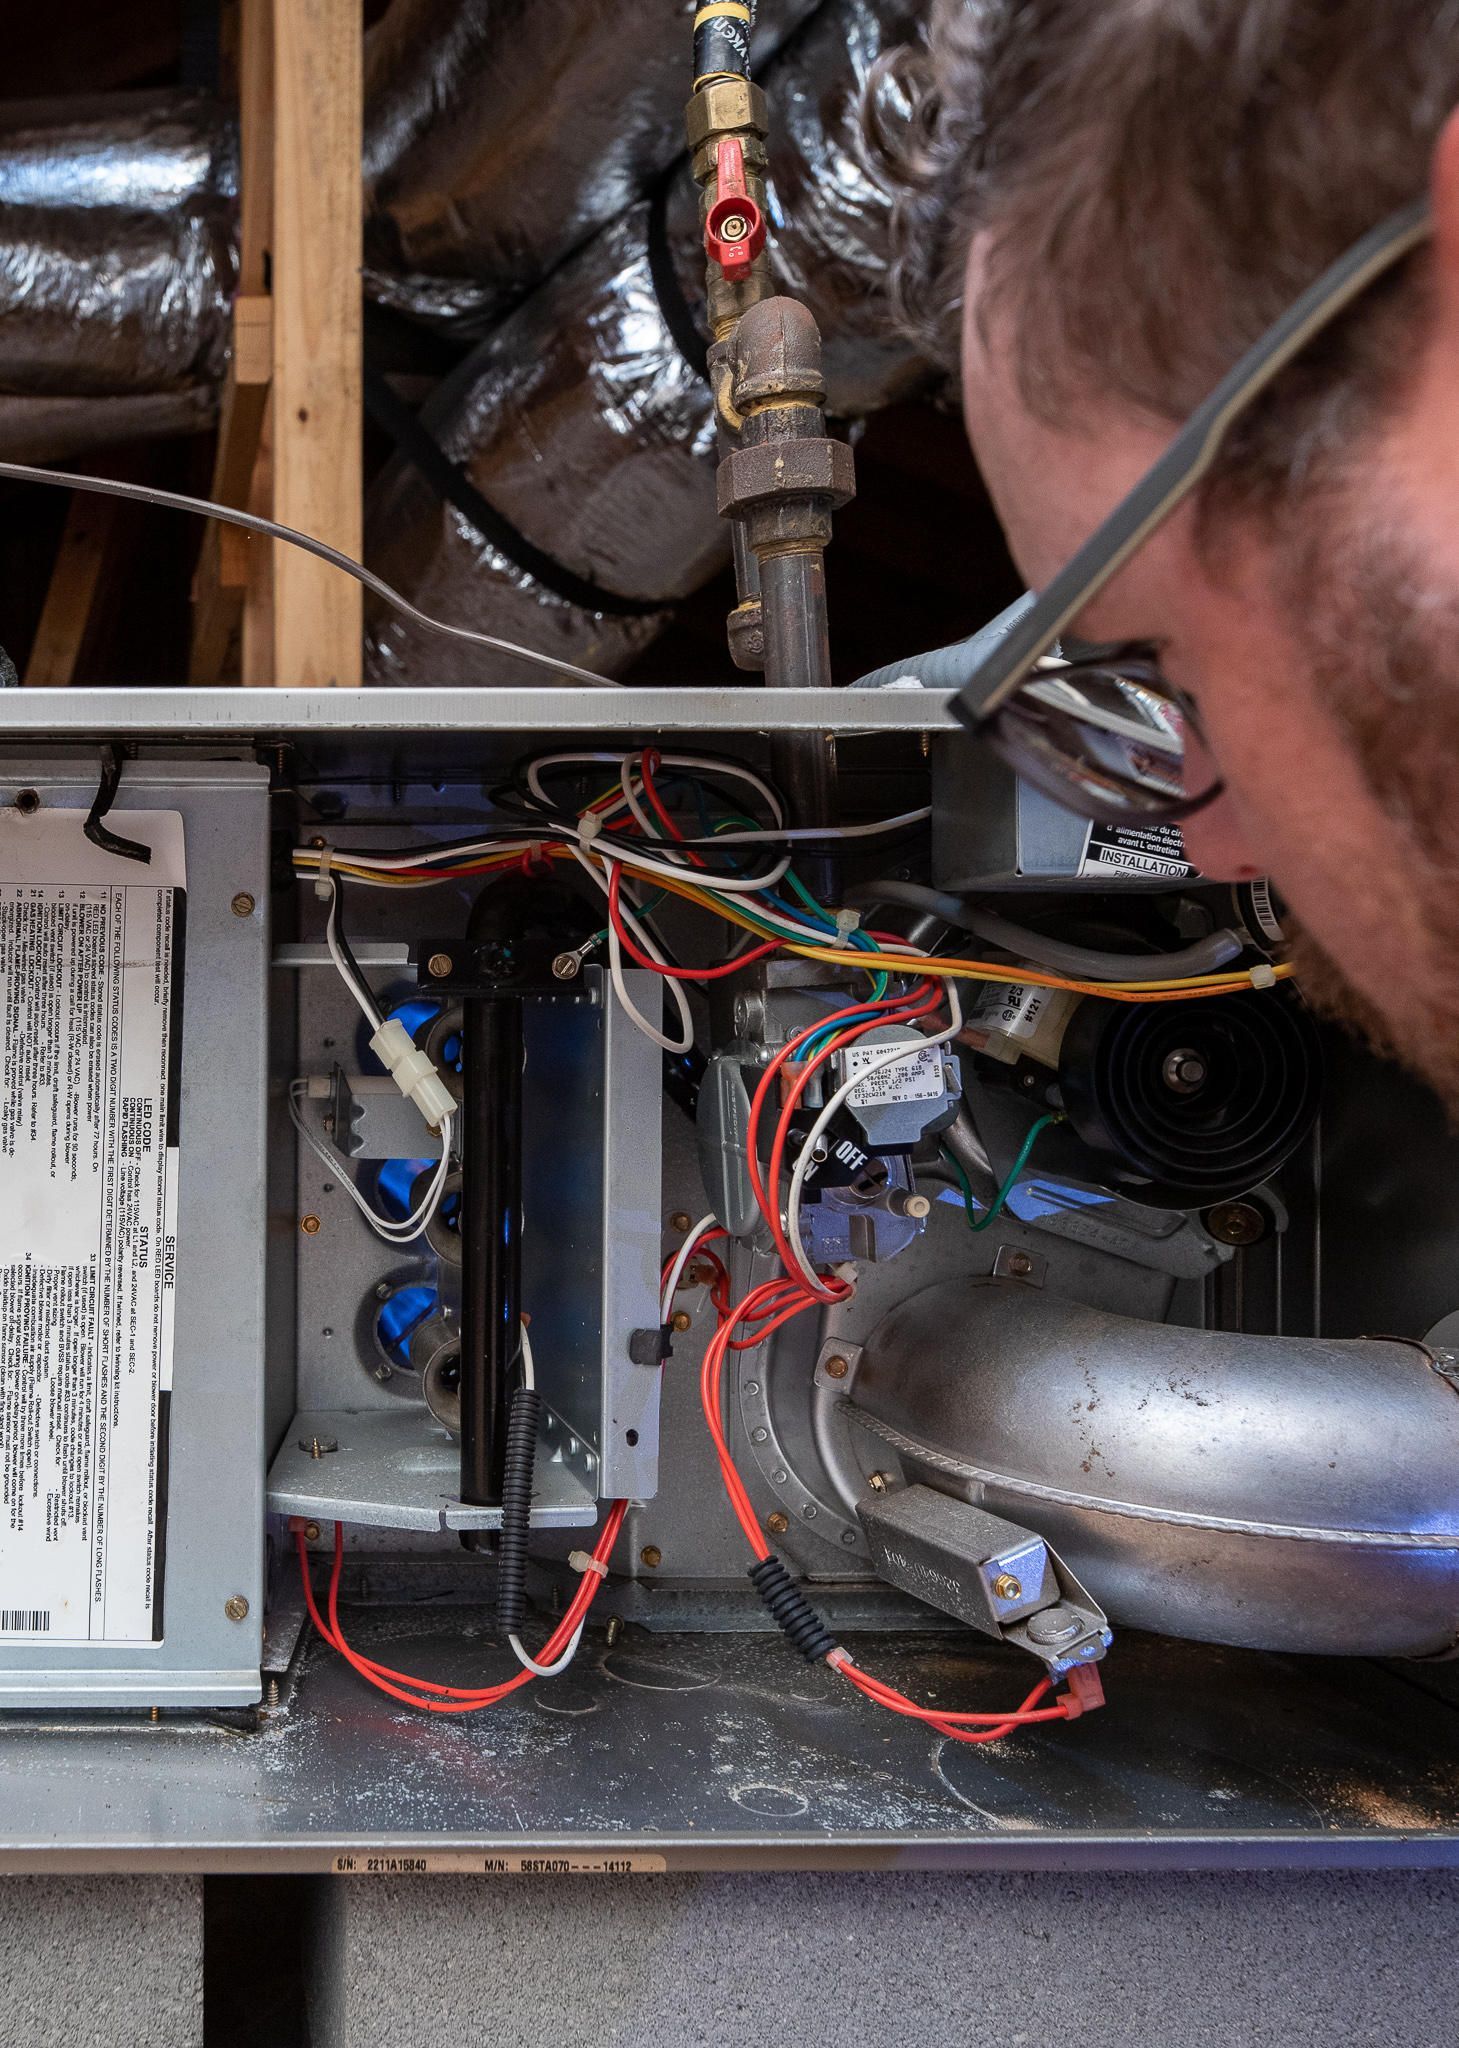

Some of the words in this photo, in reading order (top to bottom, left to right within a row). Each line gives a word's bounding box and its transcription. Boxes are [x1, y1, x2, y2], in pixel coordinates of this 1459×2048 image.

[1160, 826, 1170, 834] du
[1118, 836, 1139, 848] avant
[1101, 848, 1186, 877] INSTALLATION
[100, 904, 107, 914] NO
[115, 914, 122, 924] OF
[78, 936, 85, 947] ON
[112, 942, 122, 984] FOLLOWING
[1008, 986, 1024, 996] 2/3
[112, 986, 121, 1014] STATUS
[76, 1003, 82, 1013] UP
[1024, 998, 1042, 1023] #121
[144, 1098, 153, 1118] LED
[142, 1122, 152, 1152] CODE
[129, 1146, 135, 1157] ON
[835, 1140, 868, 1171] OFF
[803, 1161, 820, 1182] N
[118, 1207, 126, 1238] (115VAC)
[105, 1209, 113, 1256] DETERMINED
[139, 1226, 149, 1267] STATUS
[105, 1257, 112, 1267] BY
[164, 1236, 176, 1288] SERVICE
[103, 1317, 110, 1326] OF
[99, 1475, 105, 1485] BY
[97, 1535, 104, 1545] OF
[95, 1569, 103, 1602] FLASHES.
[337, 1858, 357, 1871] S/N:
[367, 1860, 426, 1872] 2211A15840
[484, 1861, 508, 1872] M/N:
